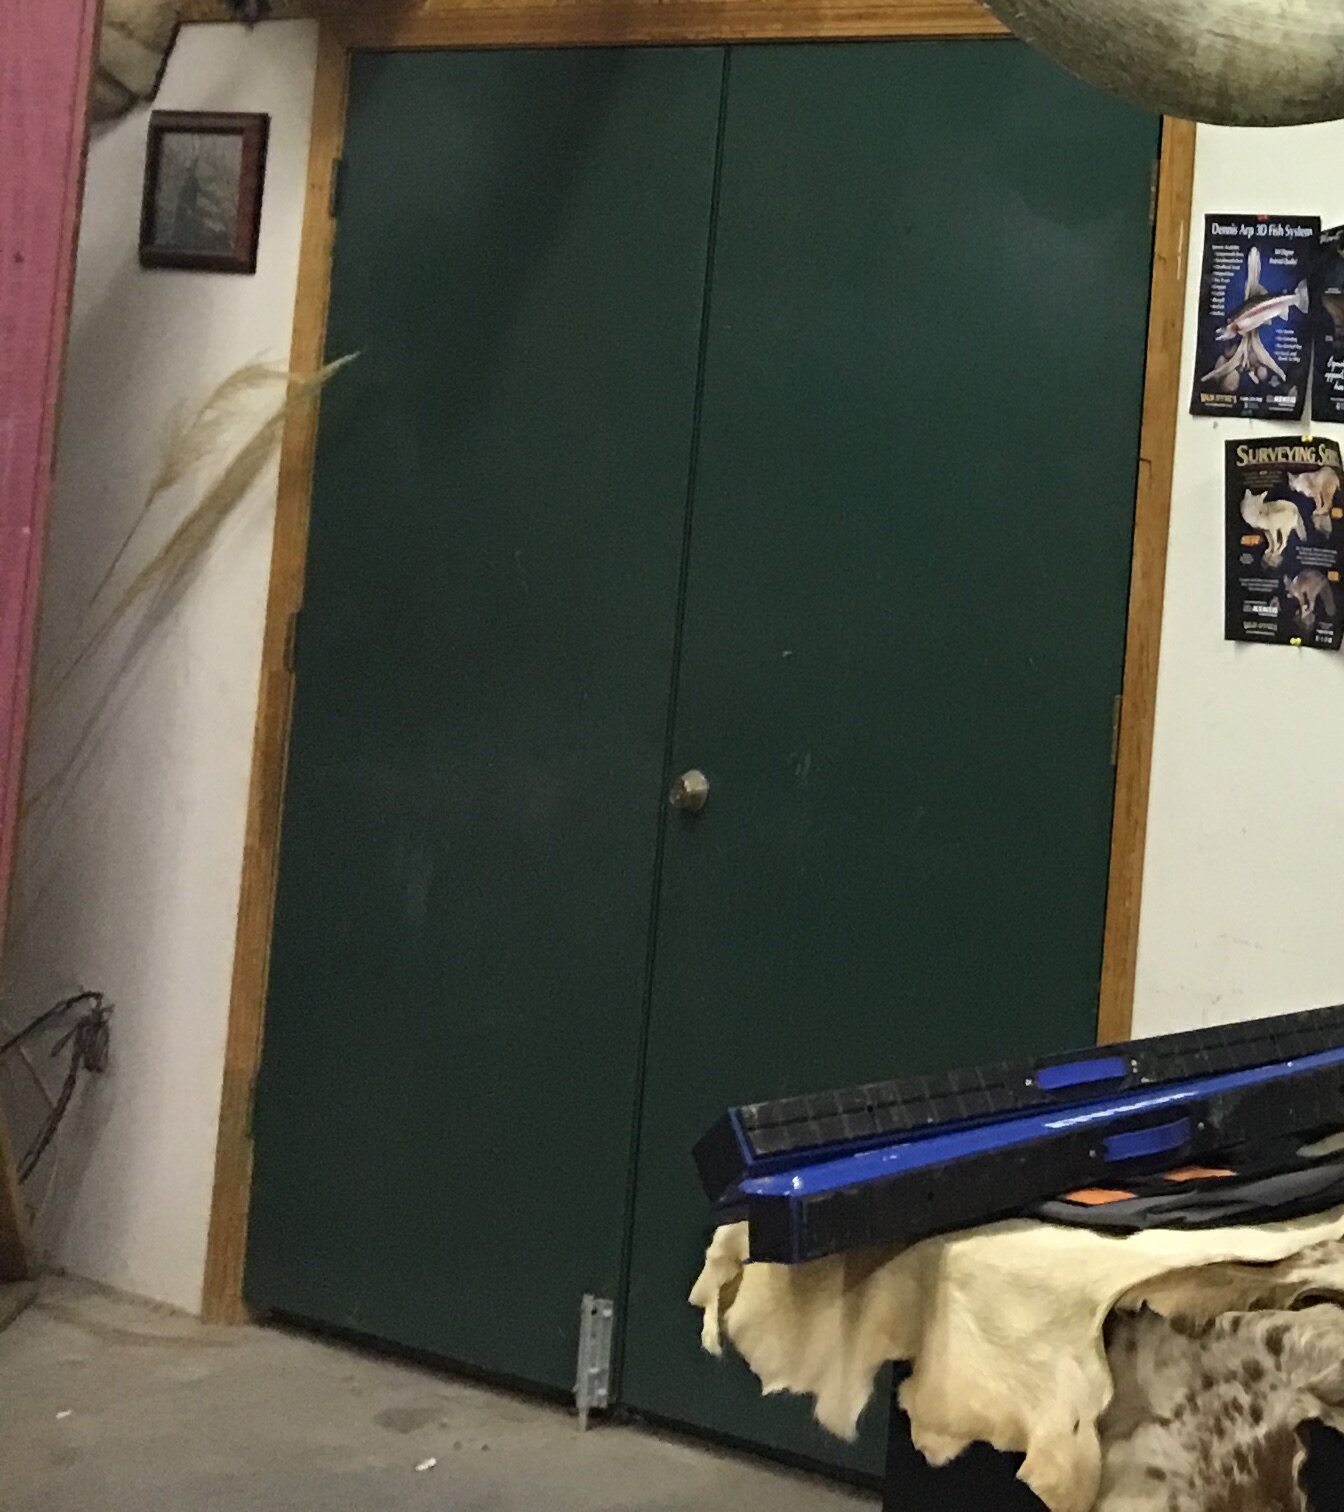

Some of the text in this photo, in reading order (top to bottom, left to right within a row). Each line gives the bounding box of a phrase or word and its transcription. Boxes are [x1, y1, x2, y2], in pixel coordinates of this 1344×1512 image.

[1211, 223, 1313, 240] Dennis Arp 3D Fish System
[1236, 445, 1316, 467] SURVEYING
